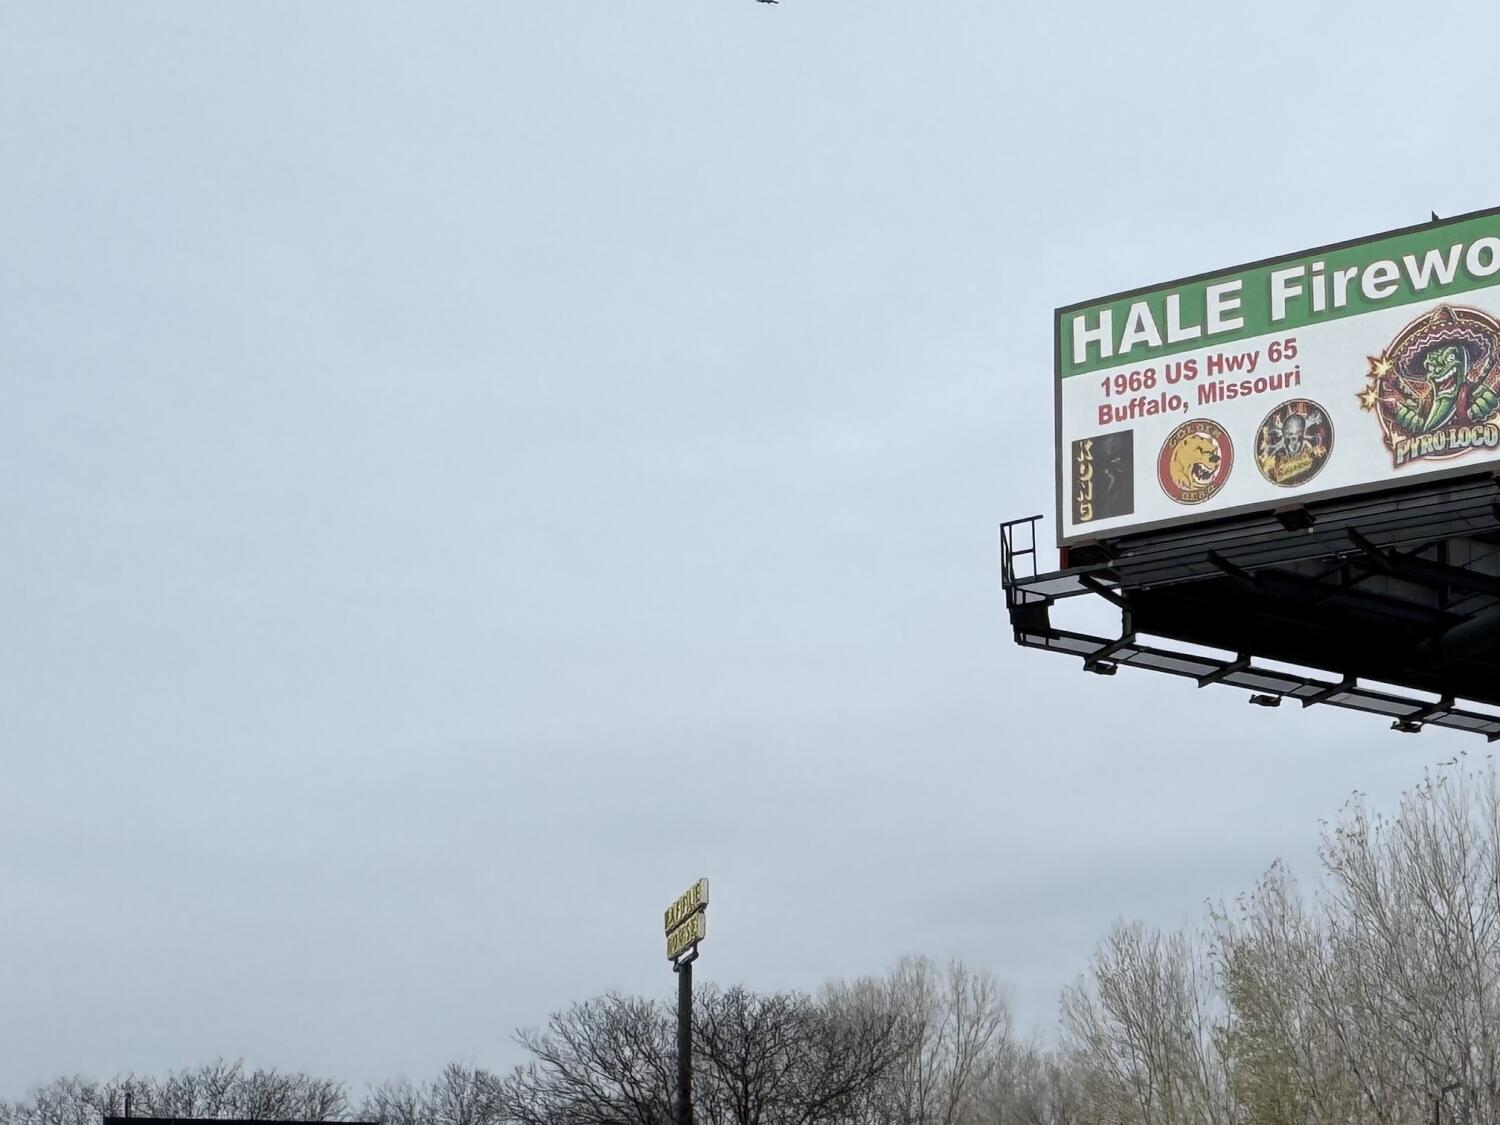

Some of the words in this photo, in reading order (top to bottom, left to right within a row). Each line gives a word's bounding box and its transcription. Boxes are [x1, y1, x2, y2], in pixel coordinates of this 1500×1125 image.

[1072, 279, 1244, 364] HALE
[1098, 395, 1189, 426] Buffalo,
[1197, 365, 1302, 407] Missouri
[1101, 367, 1157, 398] 1968
[1165, 359, 1198, 386] US
[1207, 347, 1260, 377] Hwy
[1267, 337, 1298, 362] 65
